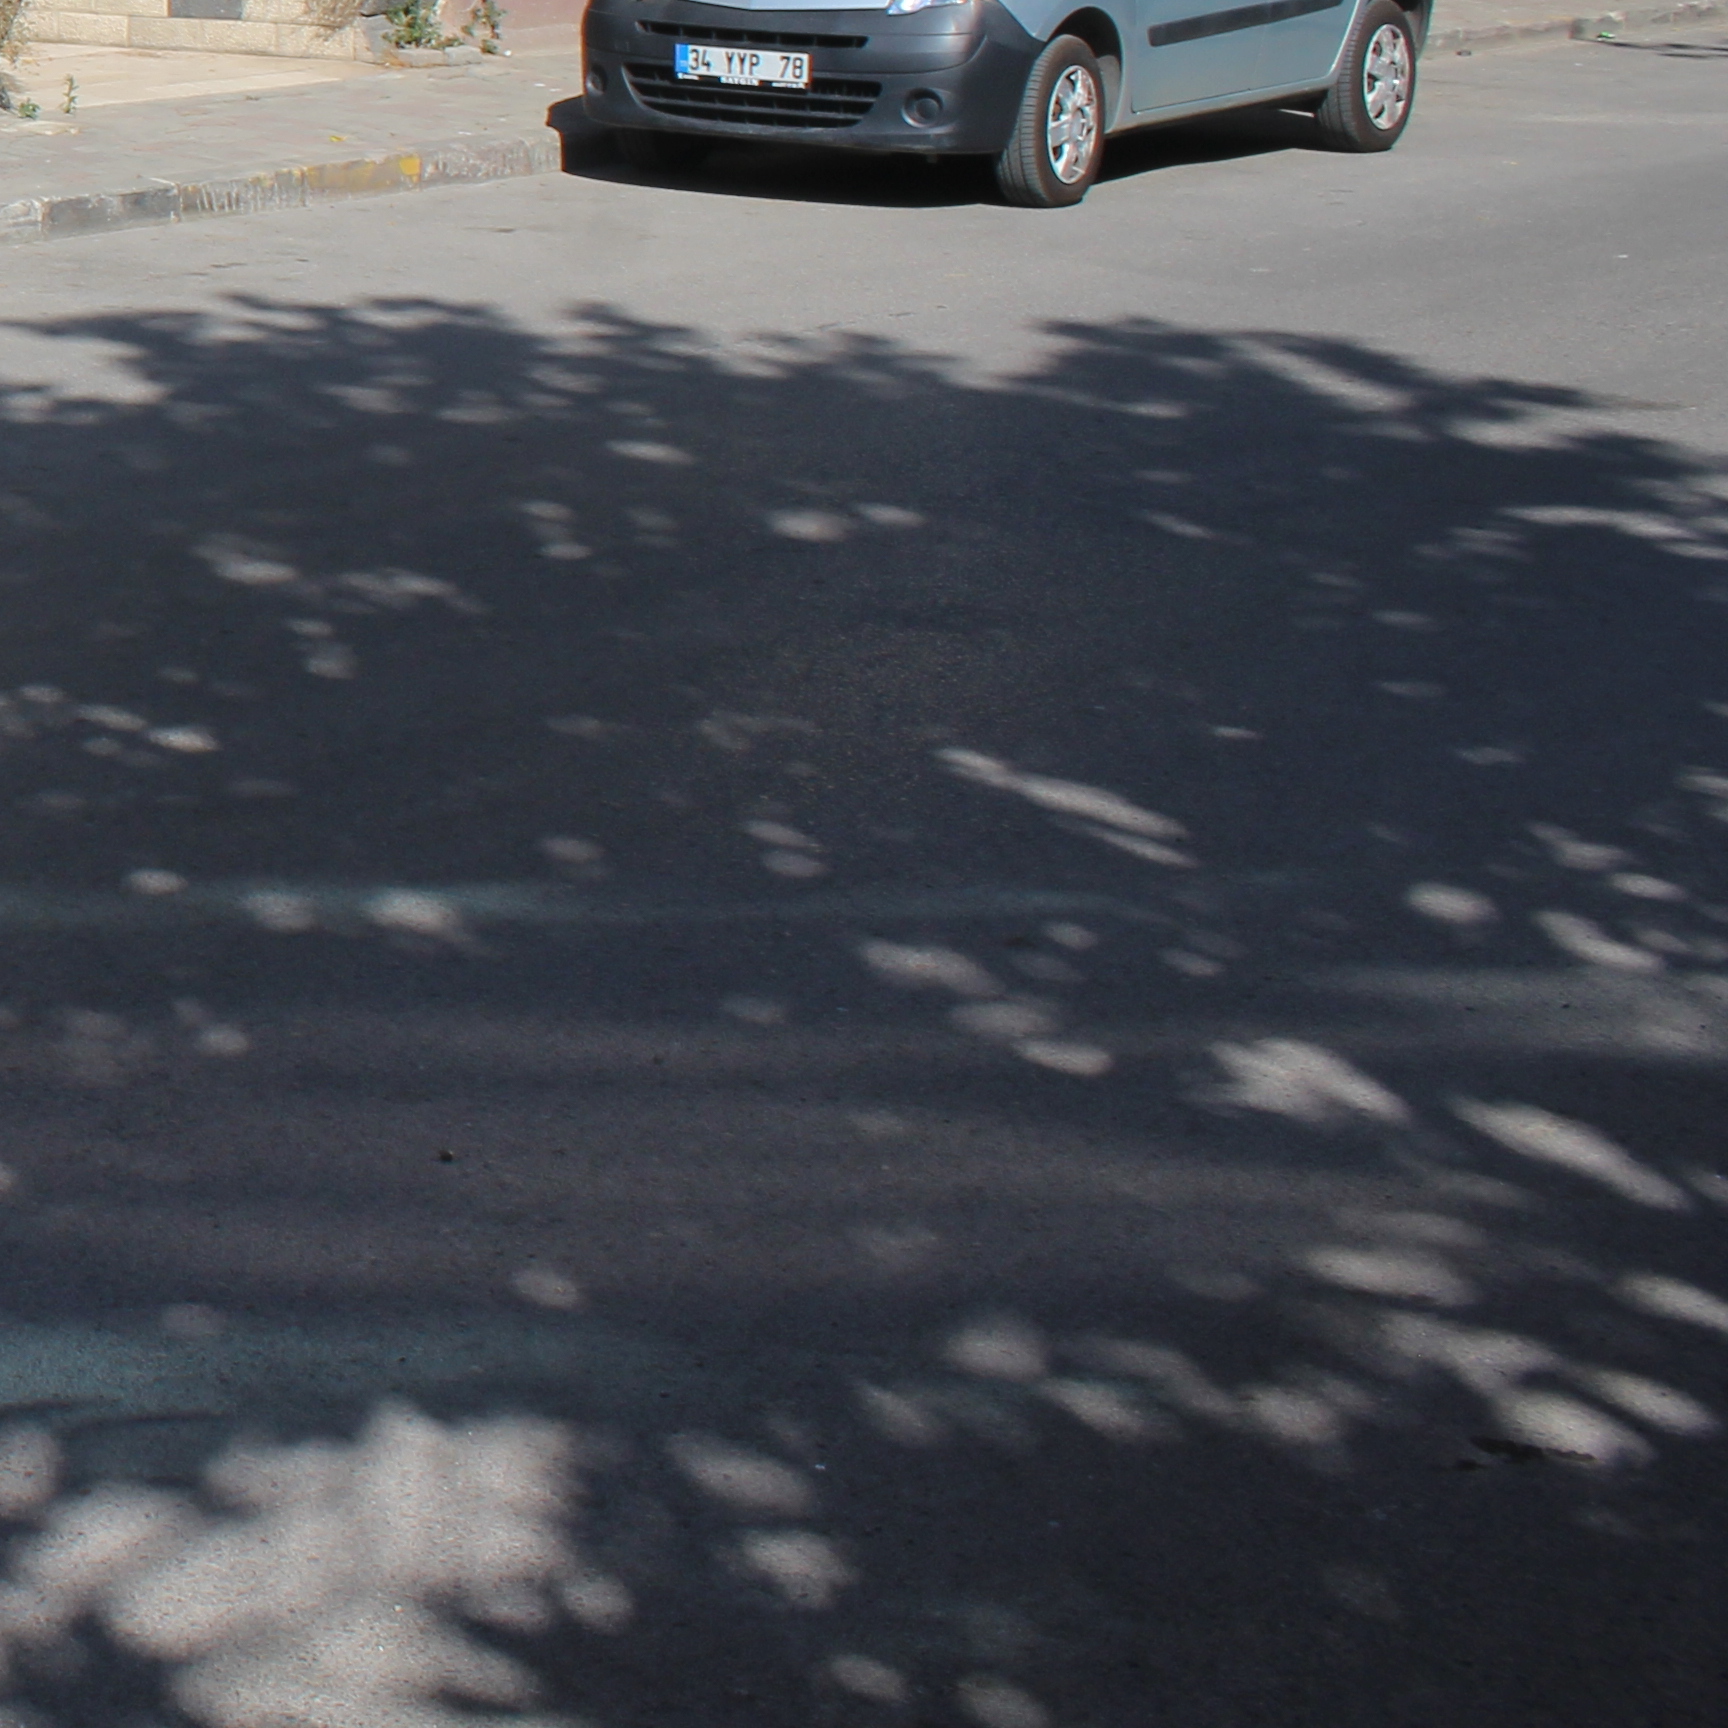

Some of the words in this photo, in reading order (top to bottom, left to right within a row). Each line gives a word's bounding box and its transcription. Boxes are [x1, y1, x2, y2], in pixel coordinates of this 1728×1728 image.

[689, 48, 711, 72] 34
[724, 51, 760, 77] YYP
[779, 55, 804, 79] 78
